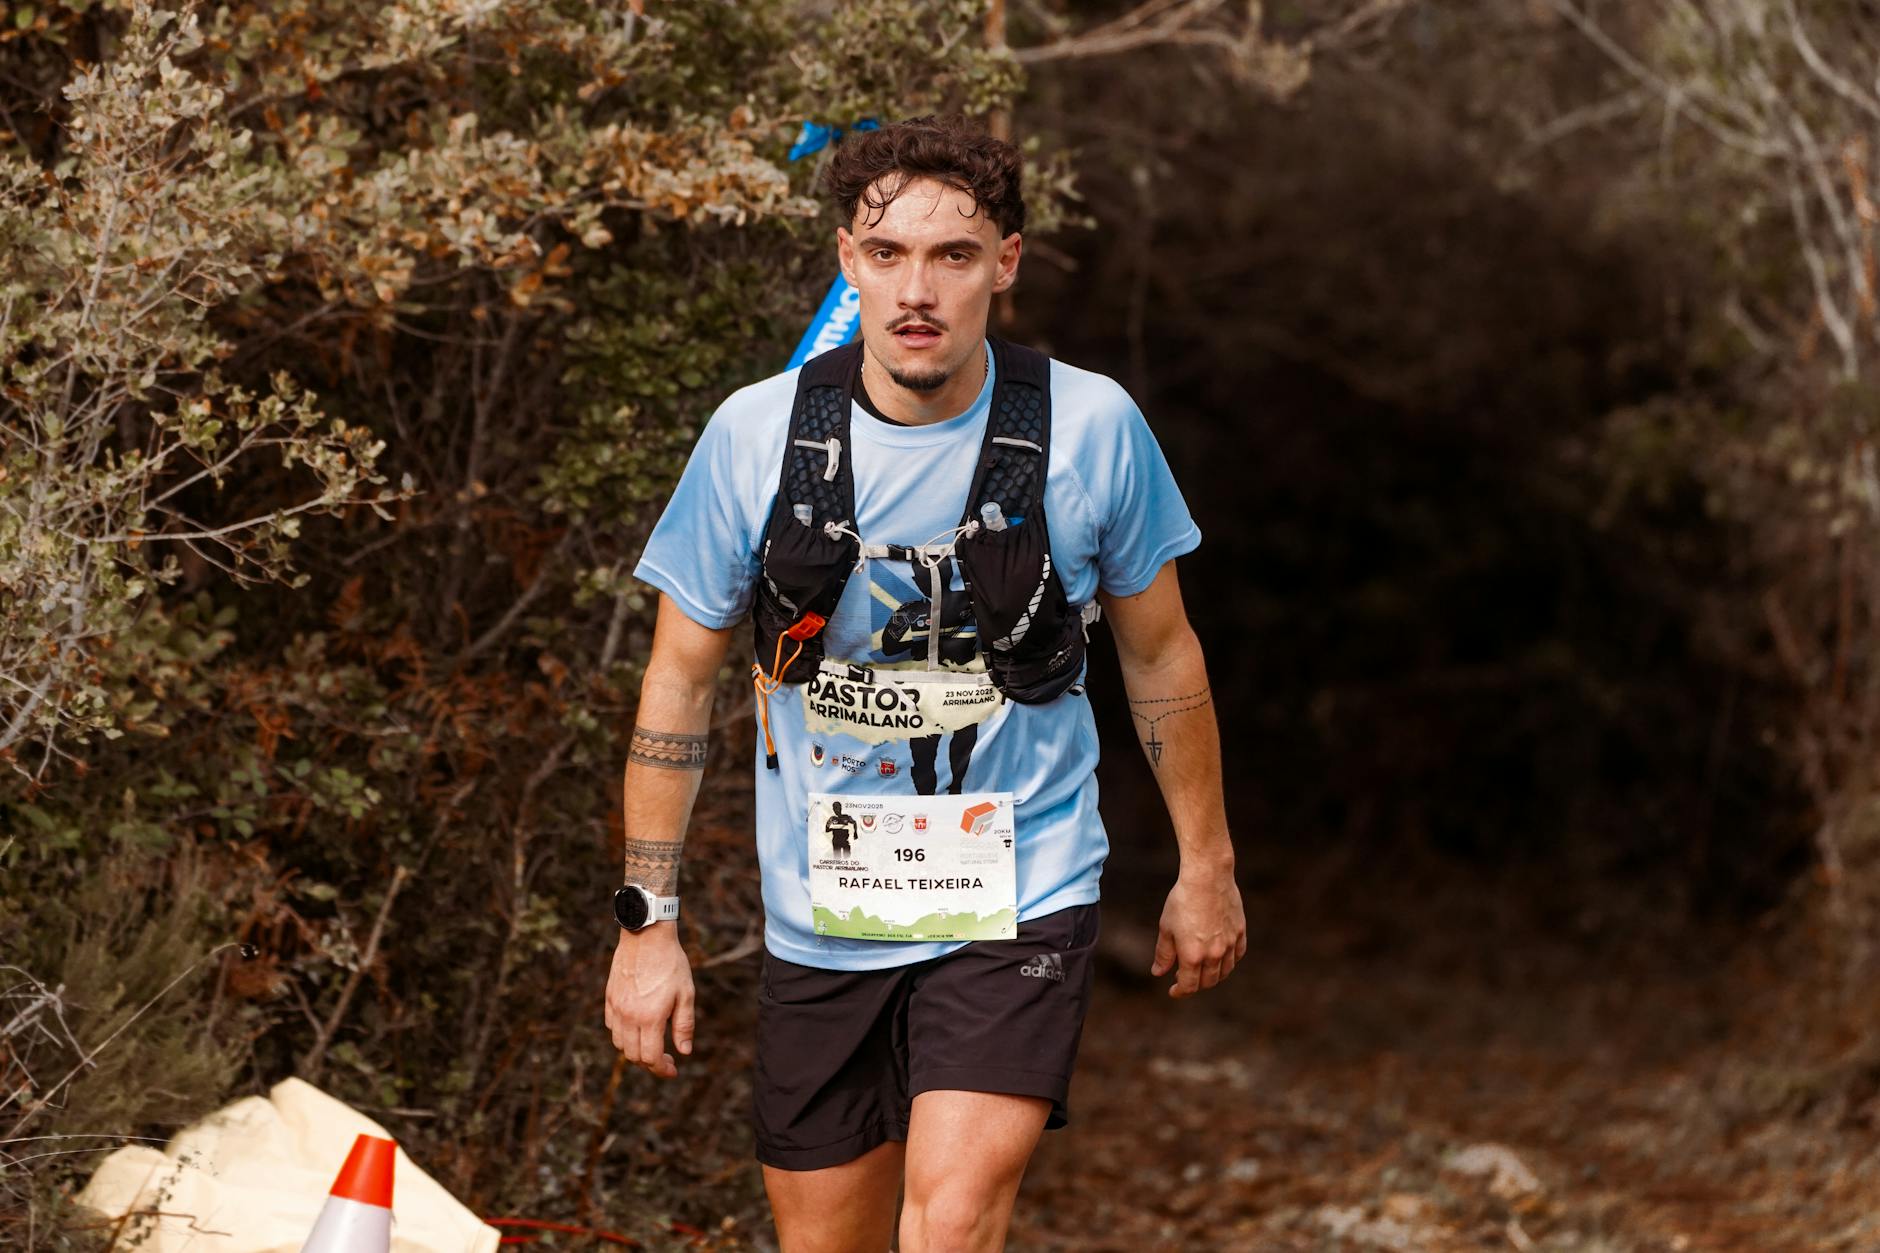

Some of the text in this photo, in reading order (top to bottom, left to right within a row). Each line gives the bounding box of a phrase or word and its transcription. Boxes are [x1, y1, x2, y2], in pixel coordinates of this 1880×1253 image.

[808, 678, 920, 711] PASTOR
[975, 688, 993, 696] 2025
[942, 695, 996, 706] ARRIMALANO
[810, 700, 924, 729] ARRIMALANO
[842, 756, 866, 768] PORTO
[894, 848, 926, 862] 196
[839, 877, 984, 890] RAFAEL TEIXEIRA
